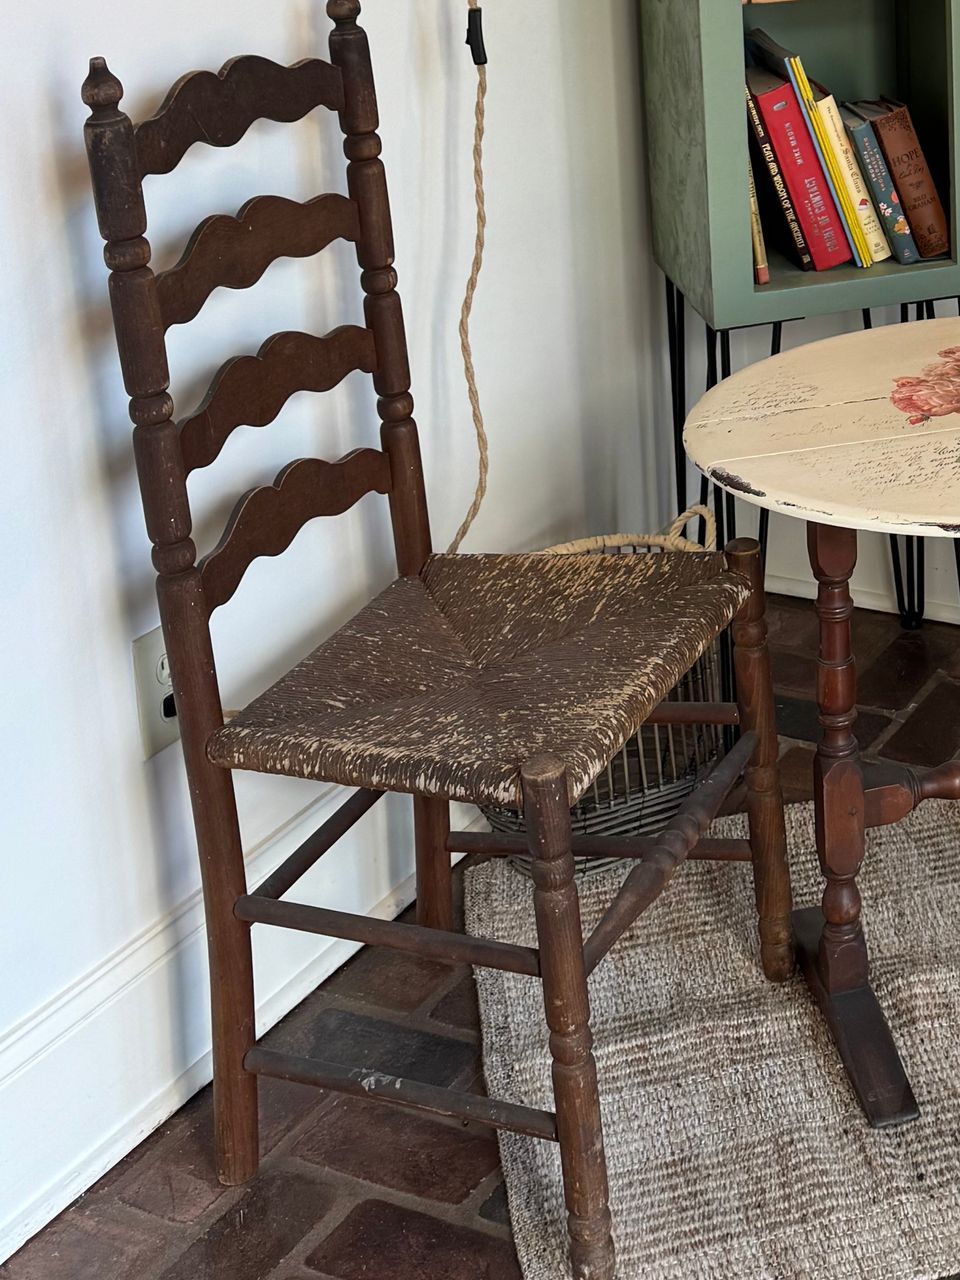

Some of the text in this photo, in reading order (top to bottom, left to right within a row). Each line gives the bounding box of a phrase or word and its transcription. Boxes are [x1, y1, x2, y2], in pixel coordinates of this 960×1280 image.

[792, 148, 804, 166] MIKE
[842, 147, 854, 172] Santa
[850, 171, 862, 194] Claus
[892, 147, 921, 168] HOPE
[762, 142, 805, 248] FEATS AND WISDOM OF THE ANCIENTS
[804, 176, 826, 214] CONTACT
